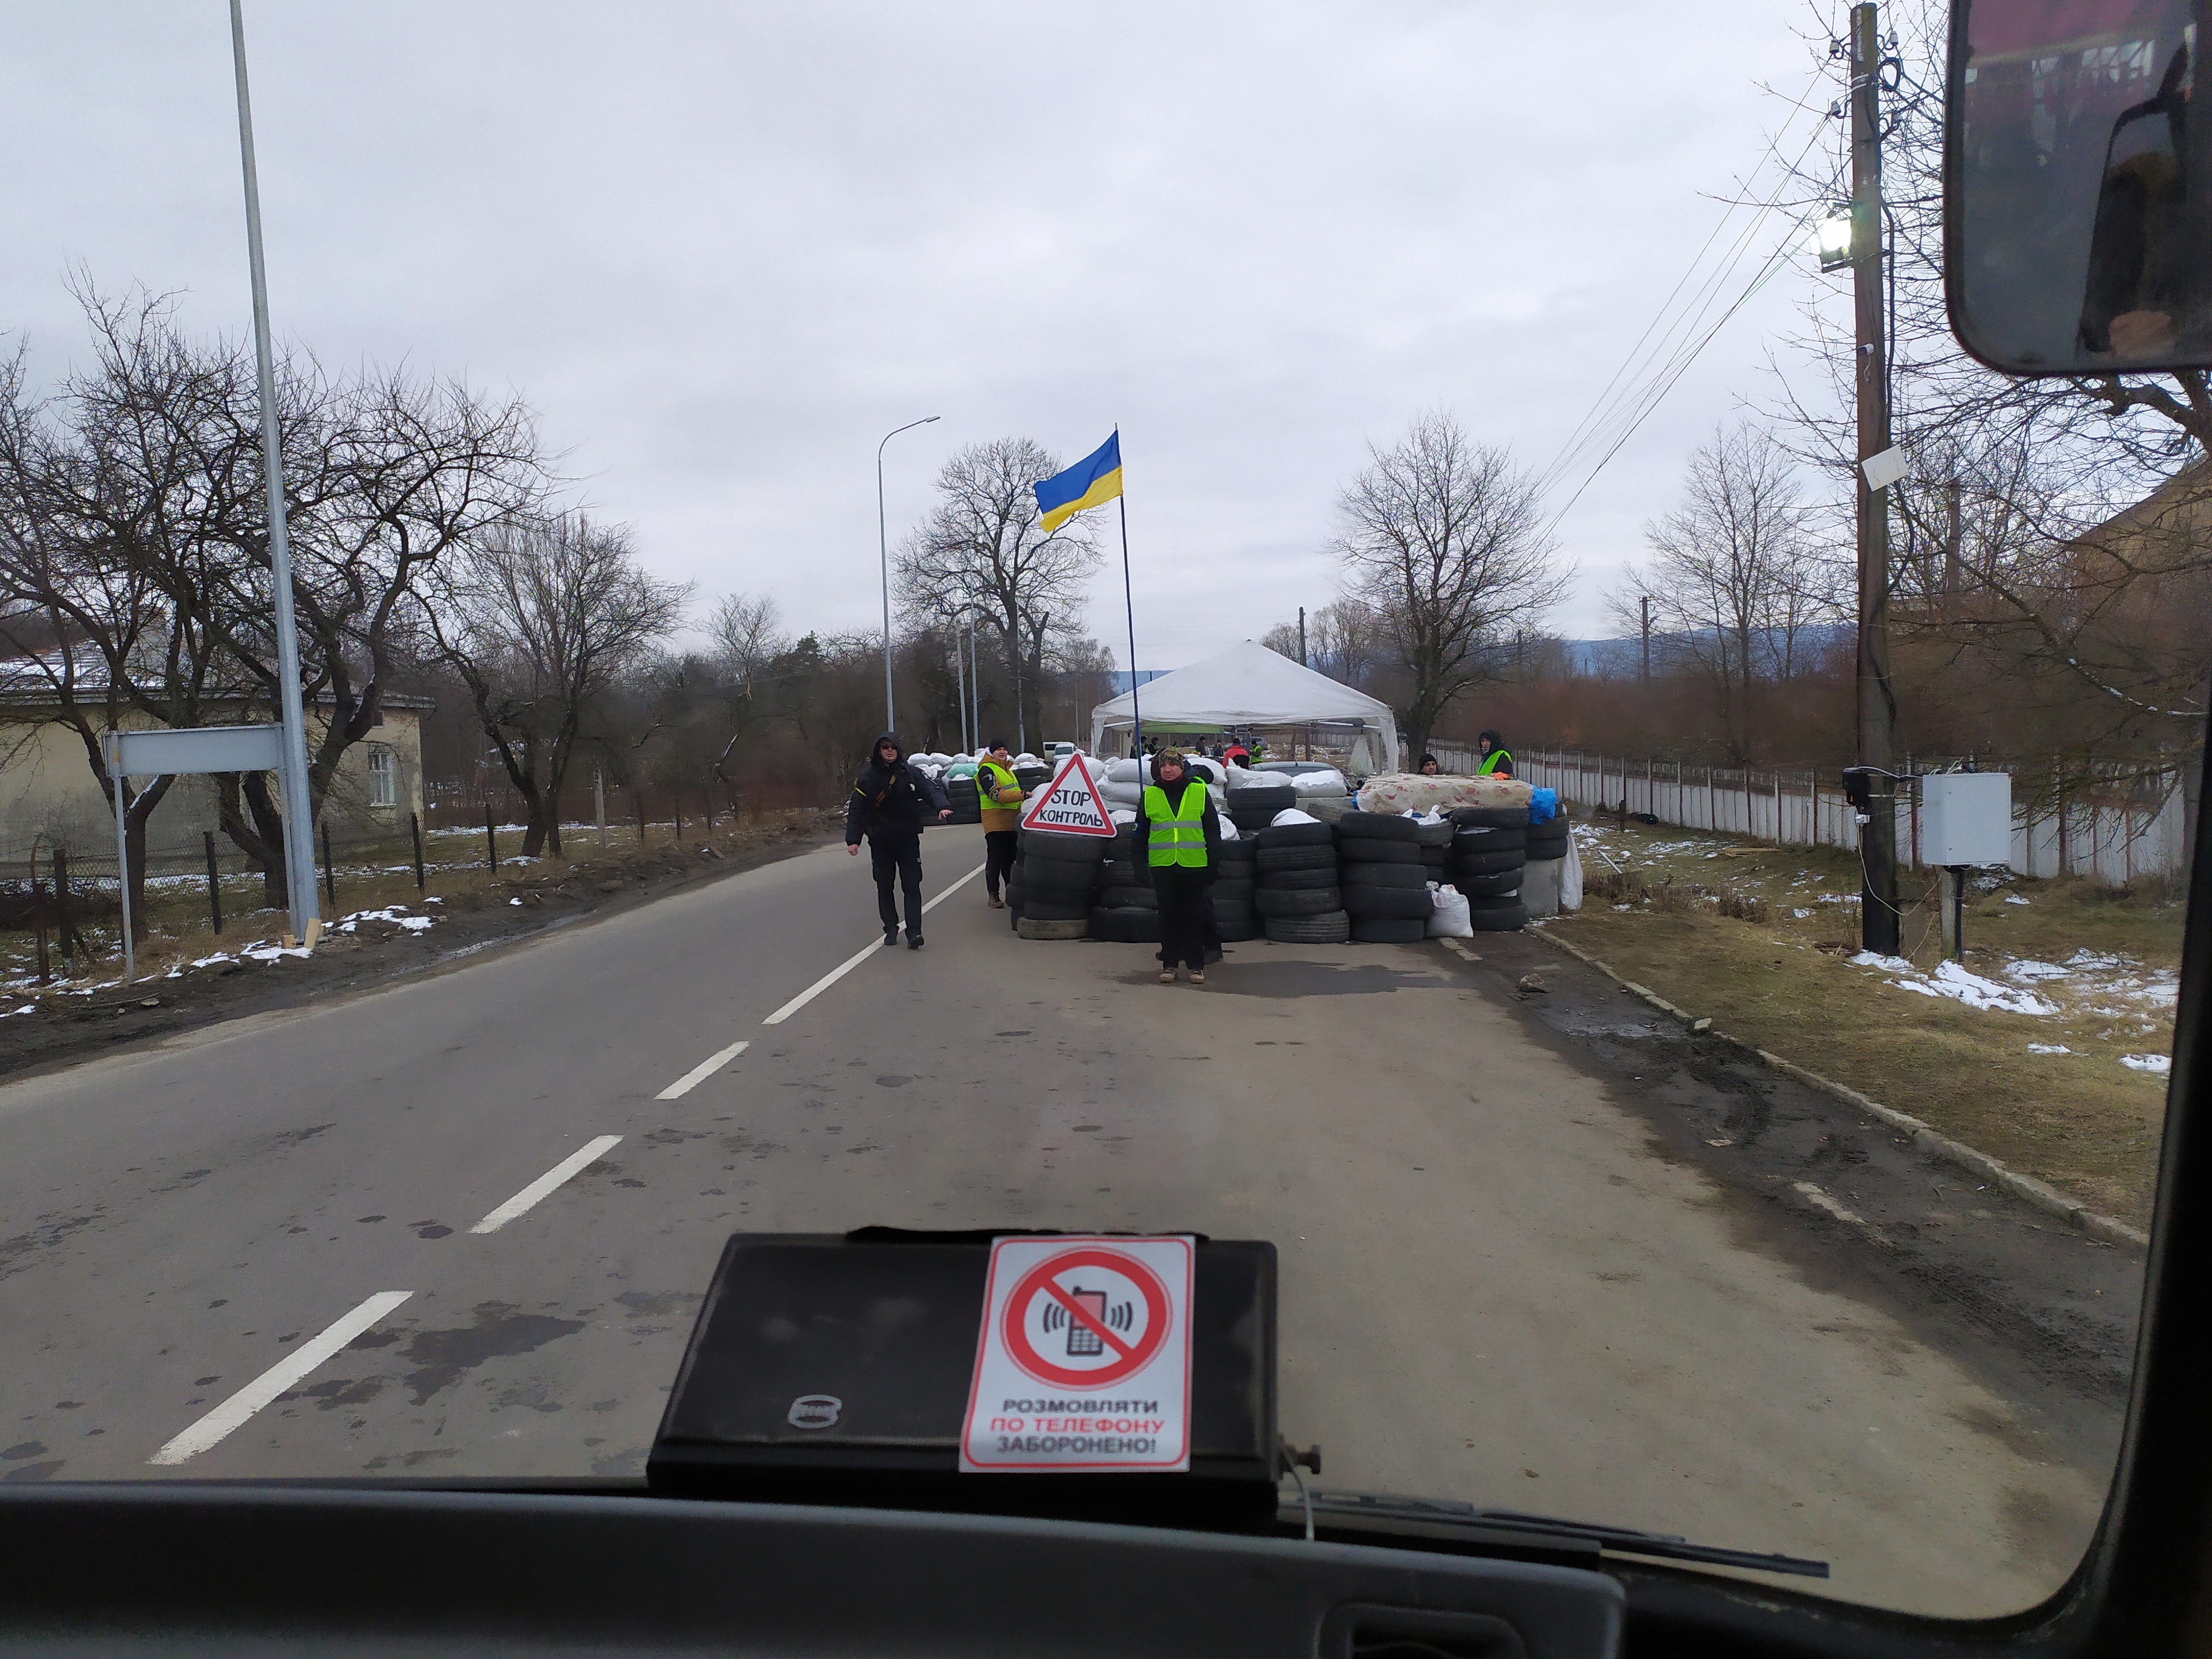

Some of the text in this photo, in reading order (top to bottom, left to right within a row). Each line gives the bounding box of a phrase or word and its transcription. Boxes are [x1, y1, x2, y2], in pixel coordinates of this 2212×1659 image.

[1051, 789, 1091, 806] STOP
[1040, 809, 1103, 827] КОНТРОЛЬ
[1003, 1398, 1158, 1413] РОЗМОВЛЯТИ
[990, 1417, 1165, 1434] ПО ТЕЛЕФОНУ
[997, 1436, 1157, 1454] ЗАБОРОНЕНО!
